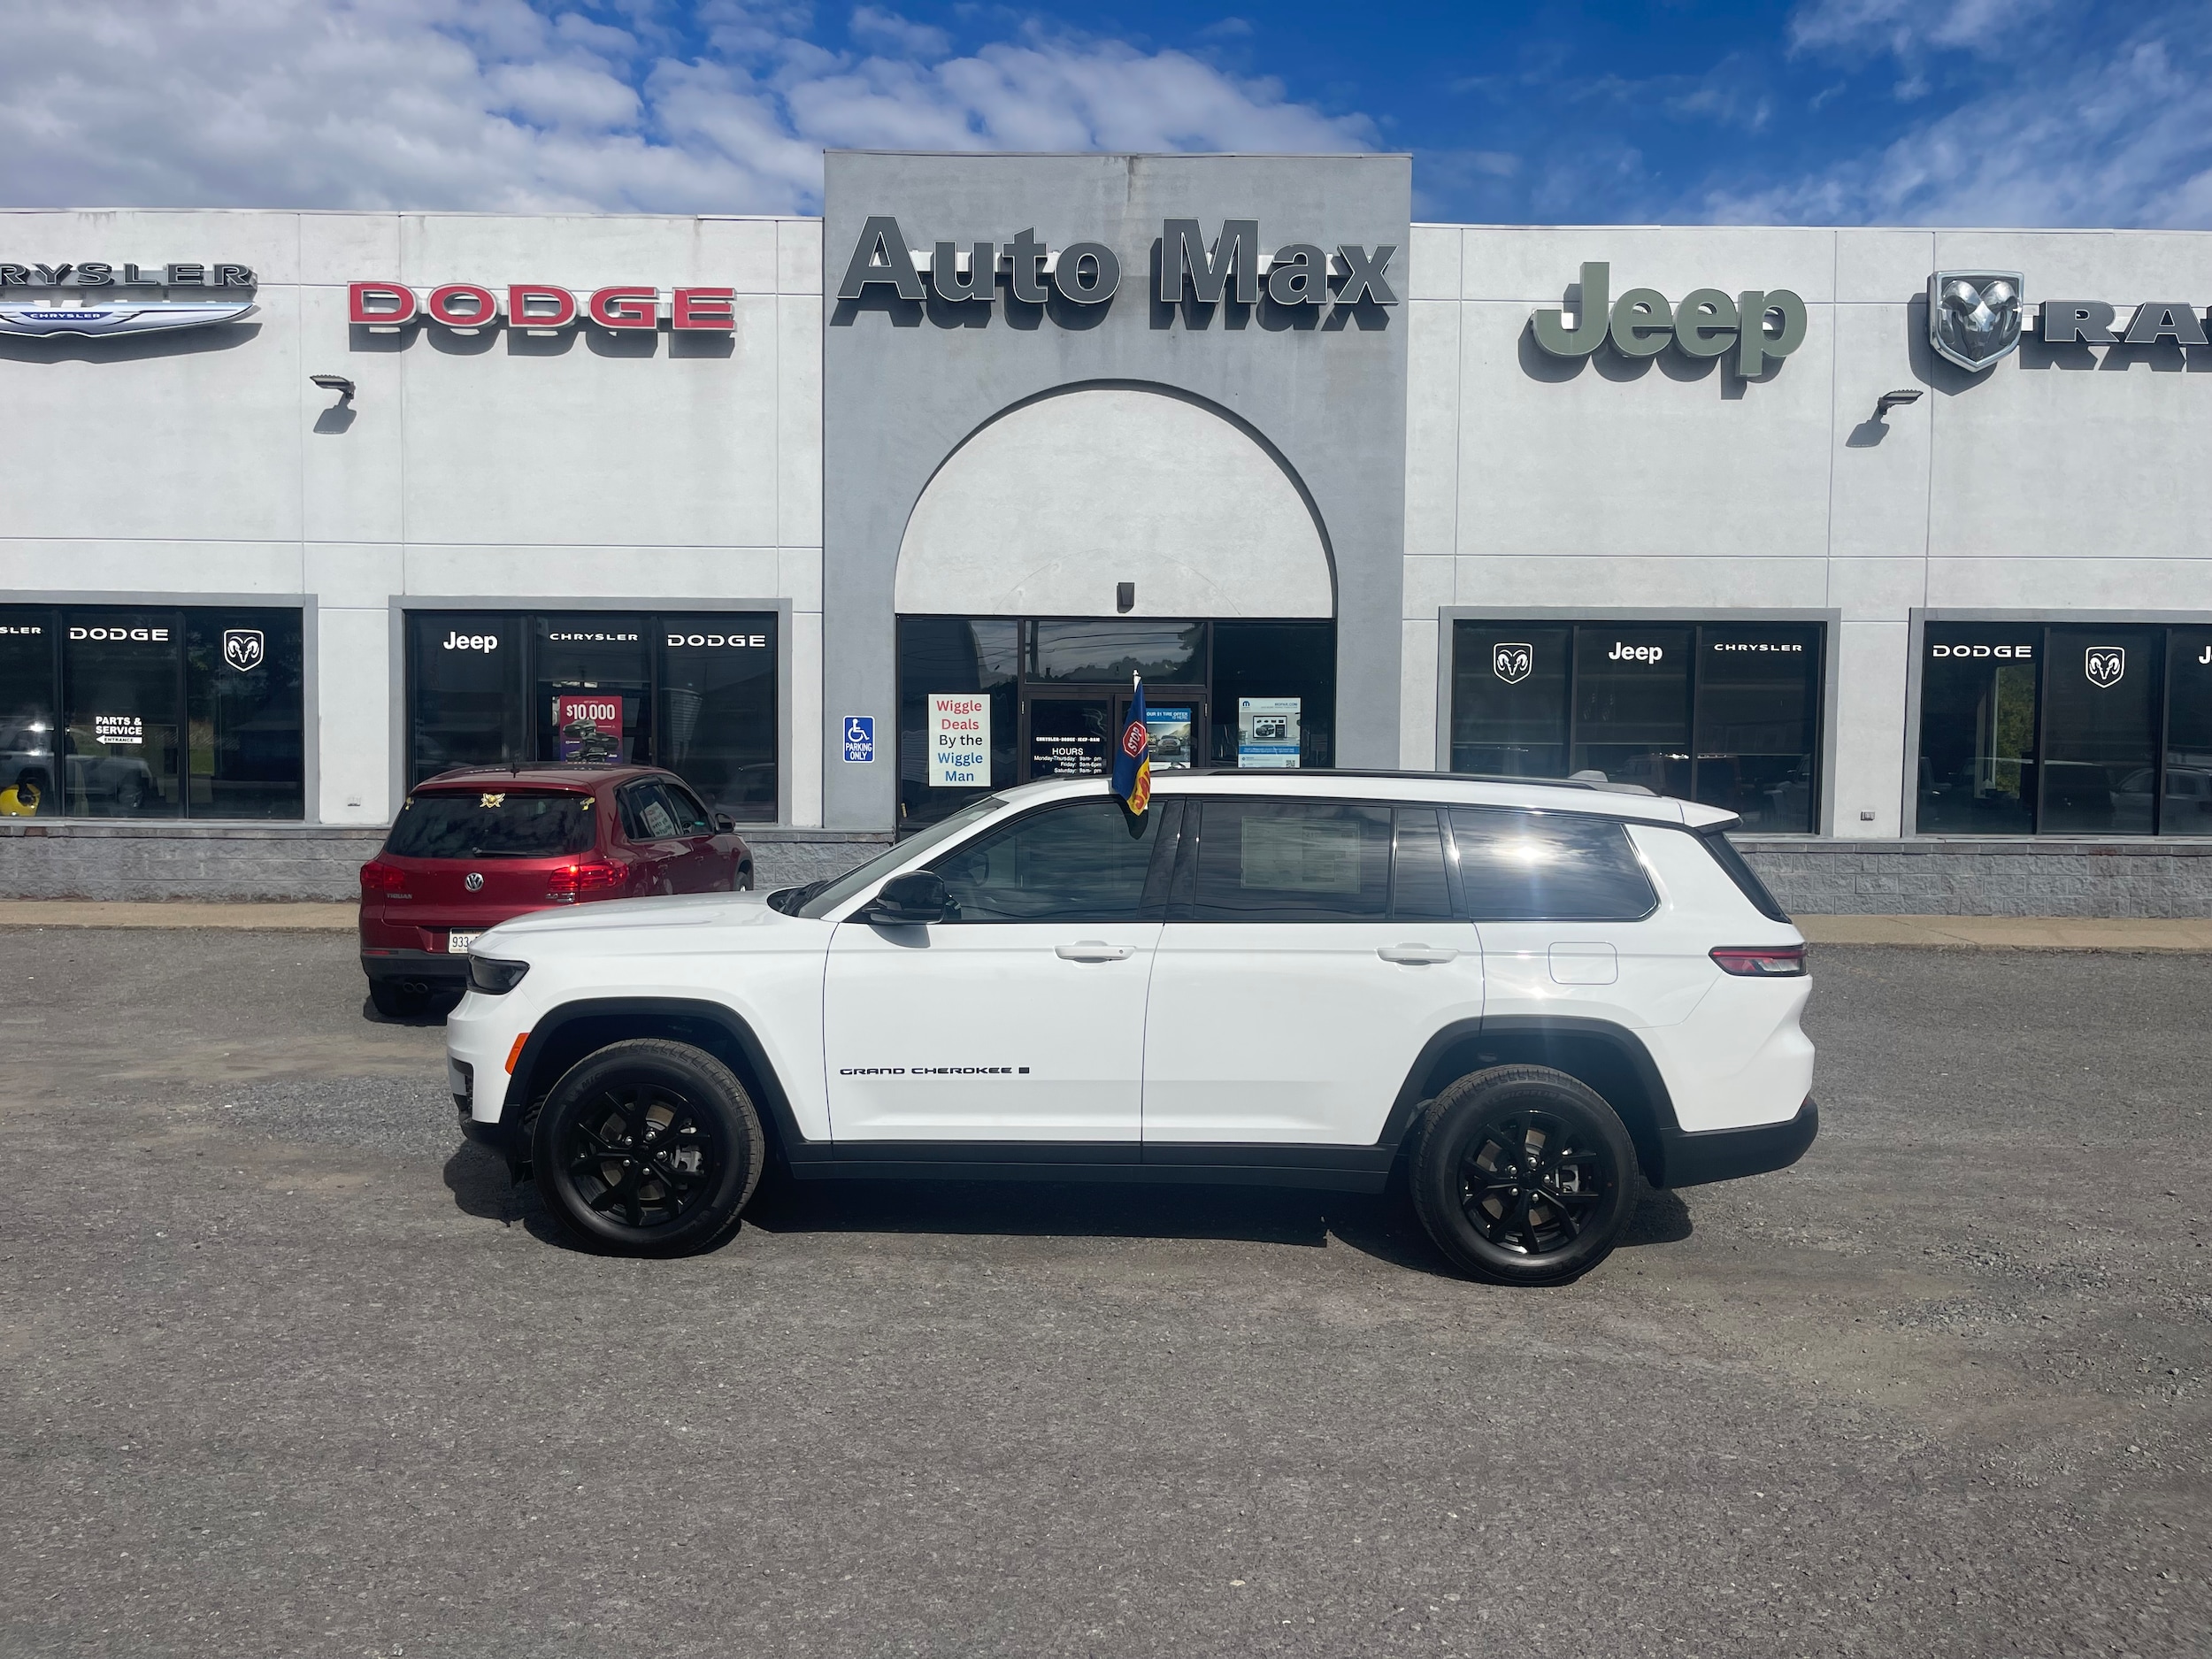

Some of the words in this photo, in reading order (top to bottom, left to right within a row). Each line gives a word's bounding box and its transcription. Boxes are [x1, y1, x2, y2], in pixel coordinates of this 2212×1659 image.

[836, 214, 1122, 305] Auto
[1160, 217, 1401, 307] Max
[347, 280, 737, 331] DODGE
[1532, 261, 1808, 378] Jeep
[2043, 299, 2212, 344] RA
[69, 626, 169, 641] DODGE
[549, 632, 638, 641] CHRYSLER
[443, 631, 498, 654] Jeep
[667, 634, 766, 648] DODGE
[1713, 642, 1803, 652] CHRYSLER
[1608, 641, 1663, 664] Jeep
[1932, 645, 2032, 657] DODGE
[566, 703, 616, 720] $10,000
[936, 700, 982, 714] Wiggle
[96, 716, 131, 726] PARTS
[134, 717, 142, 726] &
[941, 718, 979, 730] Deals
[96, 726, 142, 735] SERVICE
[939, 735, 956, 748] By
[959, 734, 983, 746] the
[1127, 726, 1142, 752] STOP
[845, 742, 872, 752] PARKING
[849, 751, 868, 761] ONLY
[937, 752, 983, 766] Wiggle
[945, 771, 974, 782] Man
